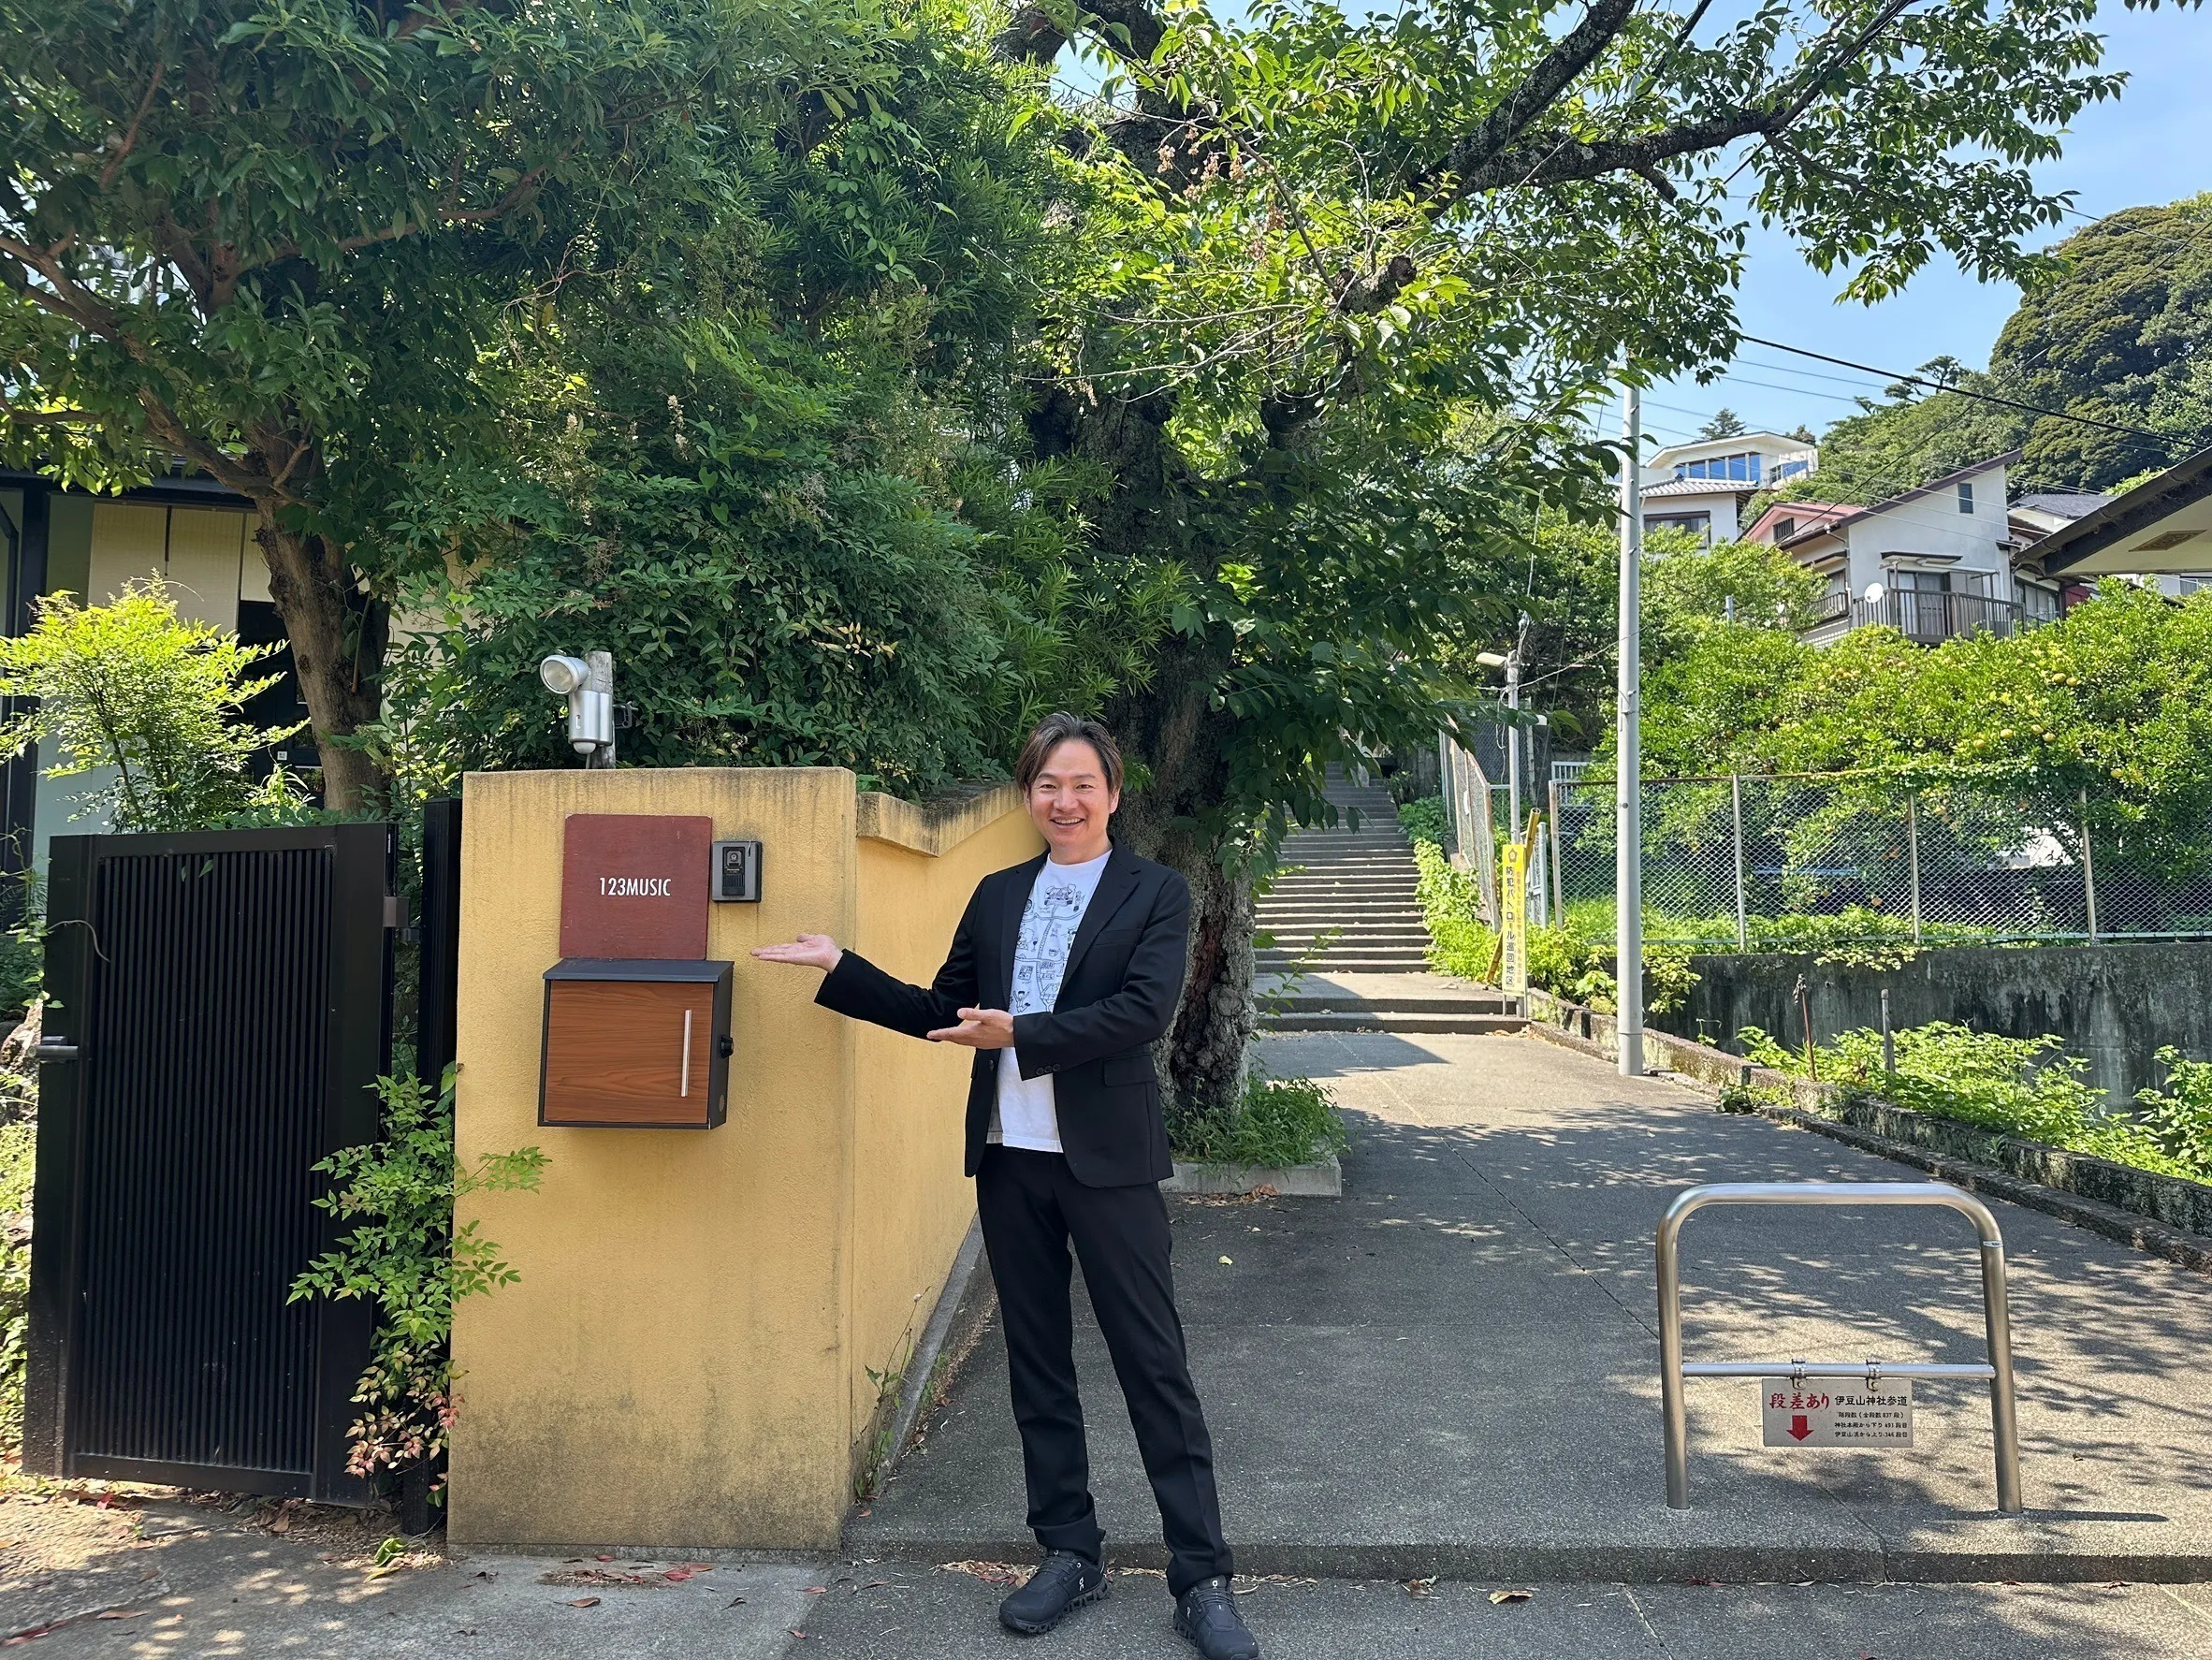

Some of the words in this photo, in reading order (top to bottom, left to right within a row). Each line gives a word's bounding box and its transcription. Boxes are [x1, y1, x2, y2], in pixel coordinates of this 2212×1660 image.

[600, 877, 672, 896] 123MUSIC
[1506, 866, 1515, 986] 防犯パトロール巡回地区
[1768, 1392, 1829, 1409] 段差あり
[1834, 1395, 1908, 1406] 伊豆山神社参道
